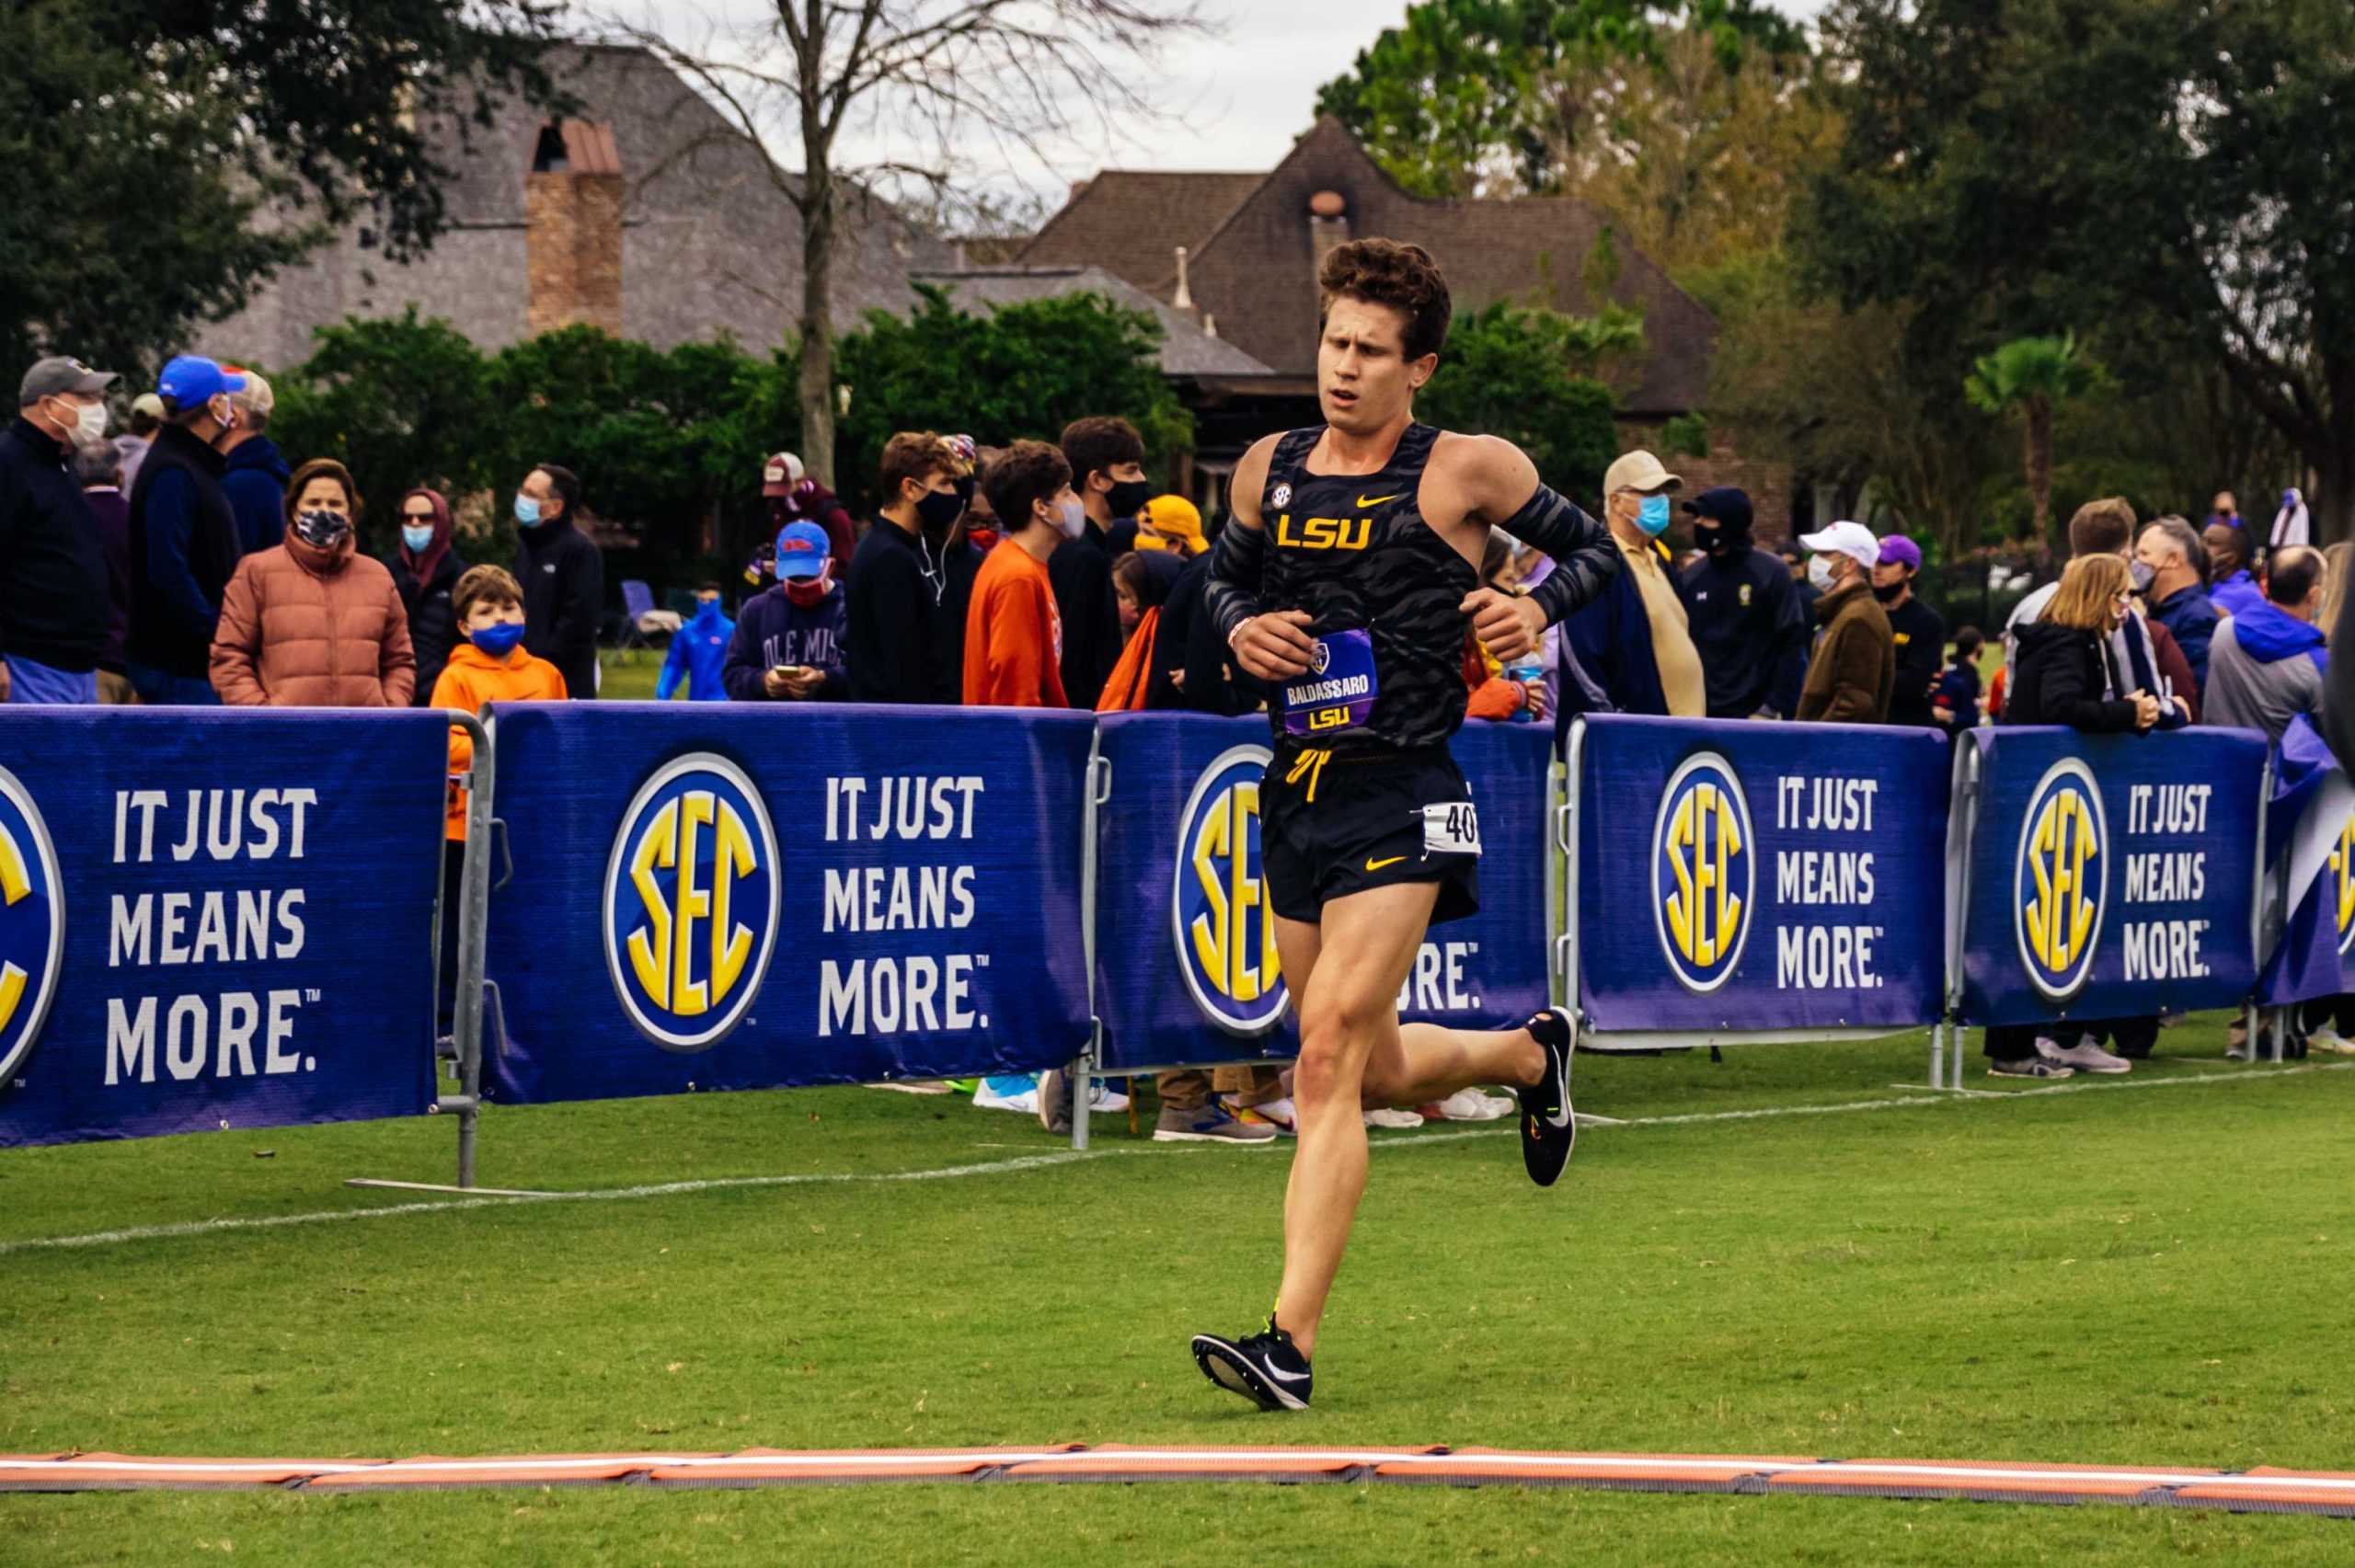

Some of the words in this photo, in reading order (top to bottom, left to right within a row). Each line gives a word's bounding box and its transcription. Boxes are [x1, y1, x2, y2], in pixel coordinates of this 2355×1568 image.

[1278, 515, 1373, 550] LSU
[1287, 674, 1369, 706] BALDASSARO
[1309, 705, 1350, 730] LSU
[114, 789, 168, 863] IT
[172, 788, 318, 862] JUST
[825, 777, 867, 841] IT
[869, 776, 985, 841] JUST
[1777, 776, 1806, 830] IT
[1807, 778, 1878, 831] JUST
[2128, 784, 2153, 834] IT
[2153, 784, 2212, 834] JUST
[626, 790, 757, 1016] SEC
[823, 865, 976, 933] MEANS
[1665, 782, 1742, 967] SEC
[1776, 851, 1875, 905] MEANS
[2025, 788, 2098, 973] SEC
[2124, 853, 2206, 903] MEANS
[109, 889, 305, 967] MEANS
